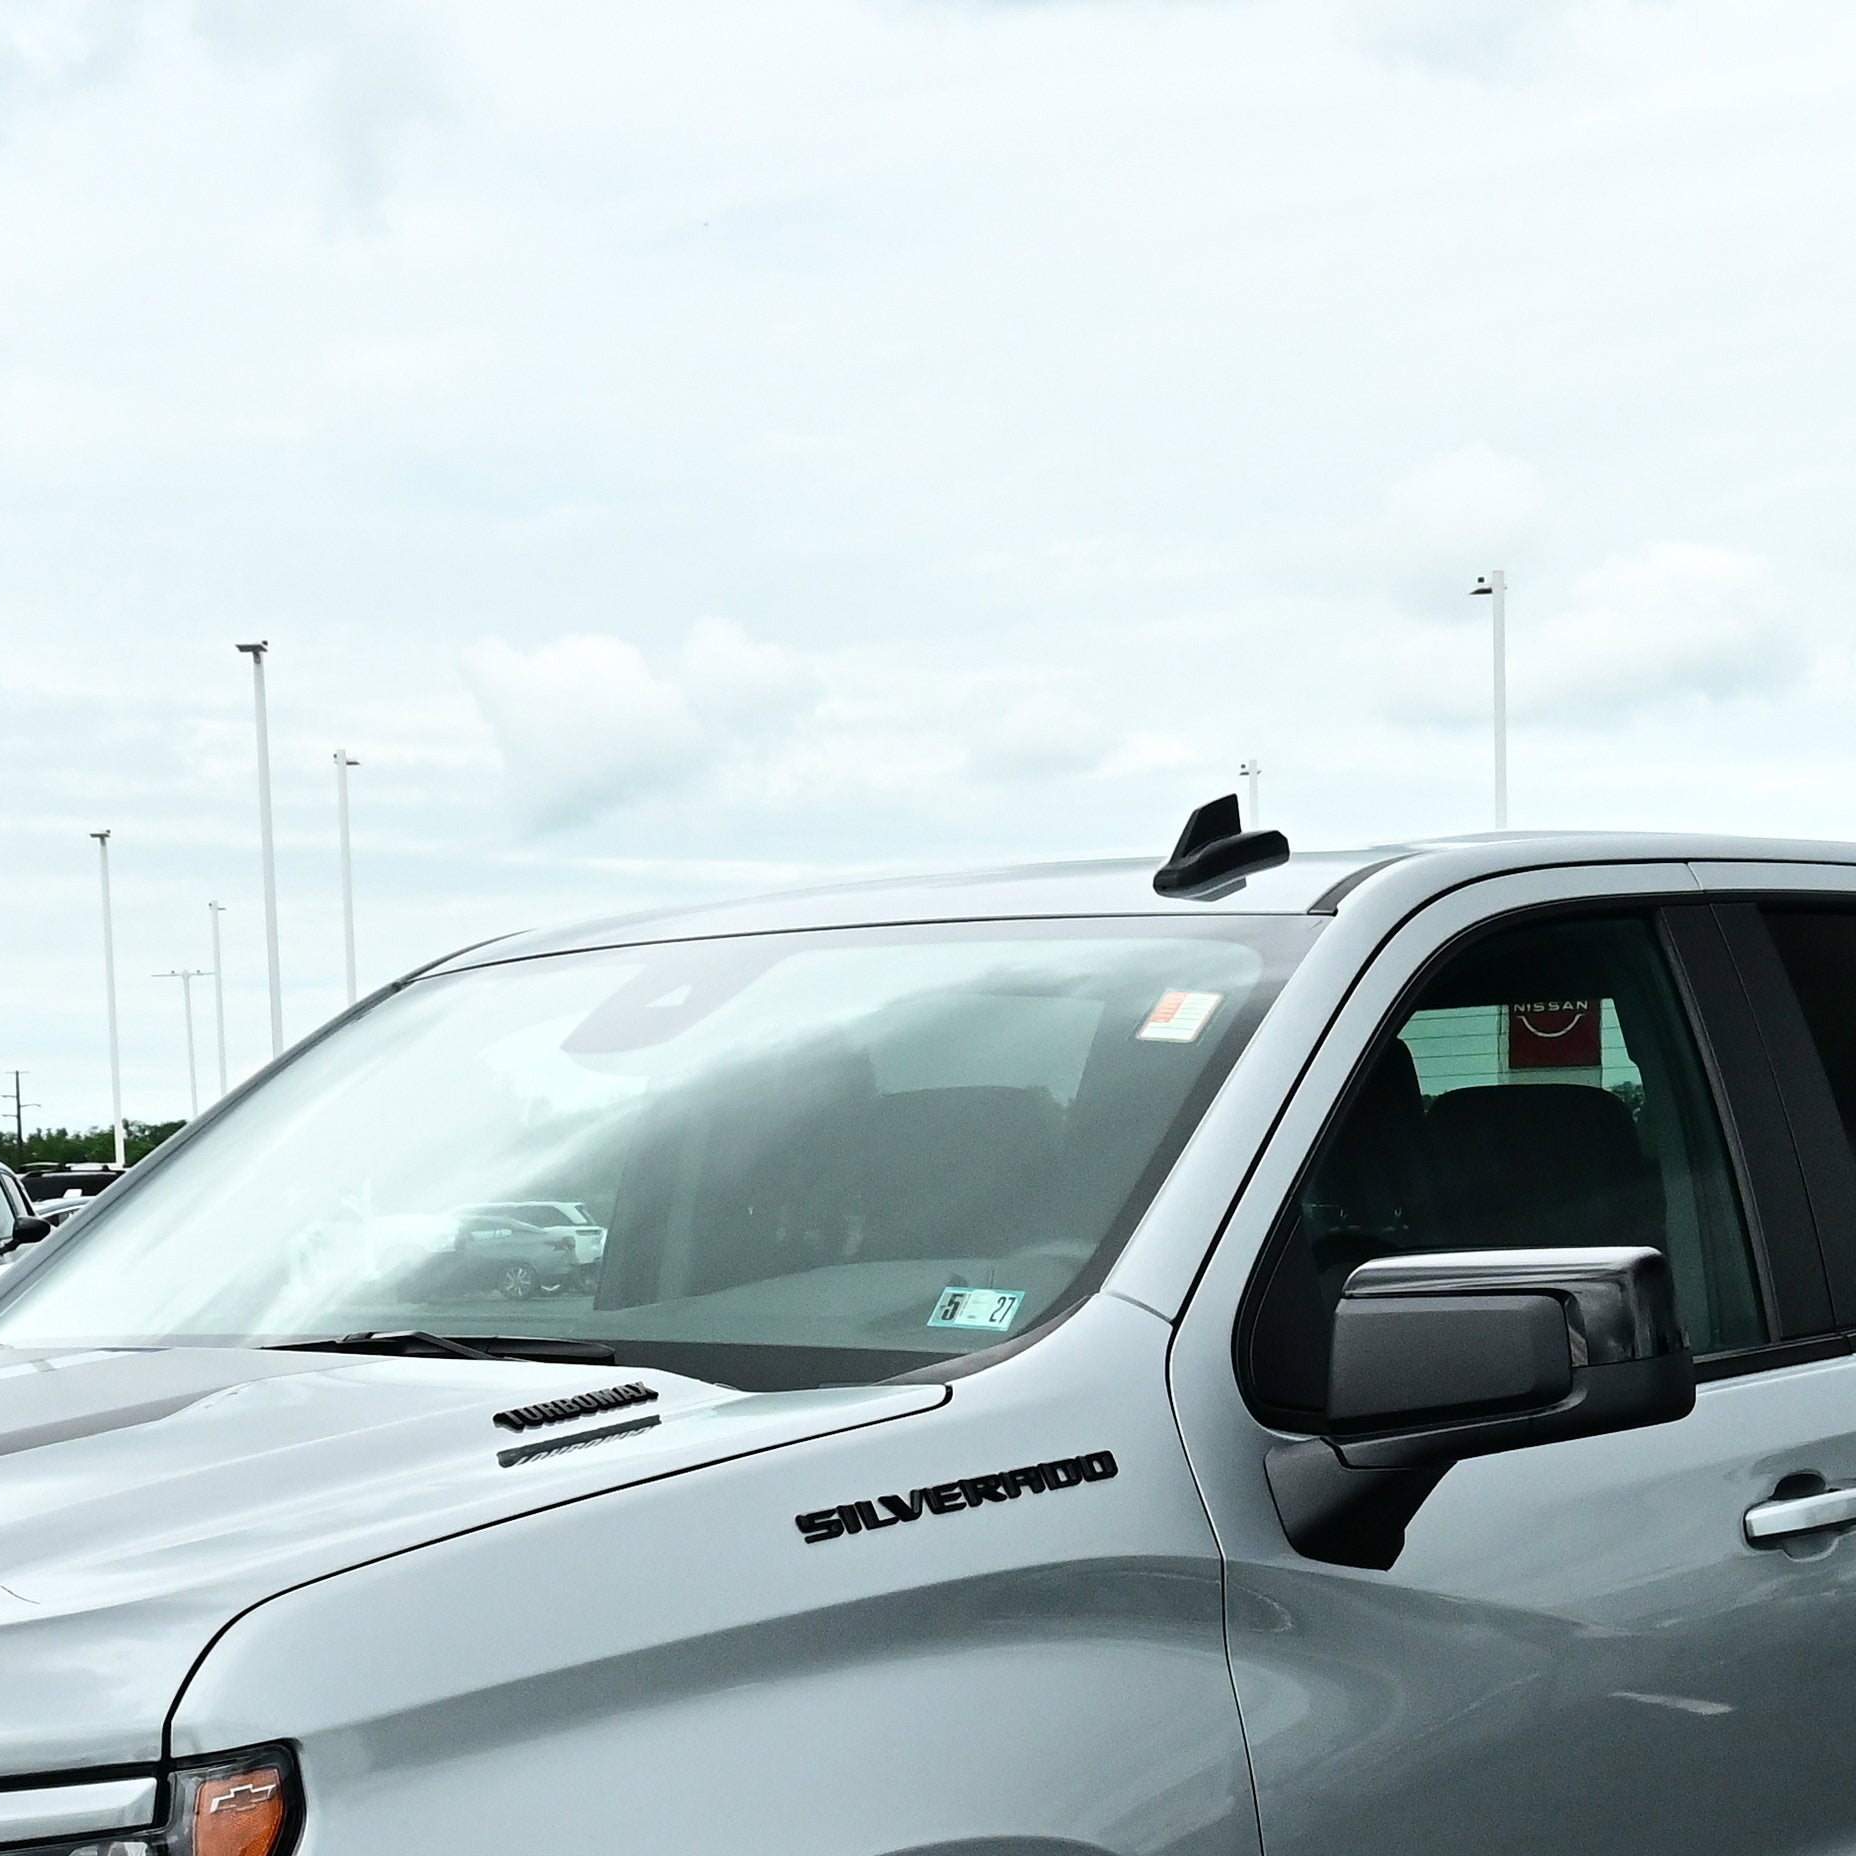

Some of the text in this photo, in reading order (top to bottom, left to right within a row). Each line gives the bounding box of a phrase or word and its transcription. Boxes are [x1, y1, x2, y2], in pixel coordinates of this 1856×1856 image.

[1513, 1000, 1588, 1013] NISSAN
[988, 1296, 1018, 1323] 27
[494, 1381, 659, 1431] TURBOMAX
[795, 1450, 1119, 1544] SILVERADO
